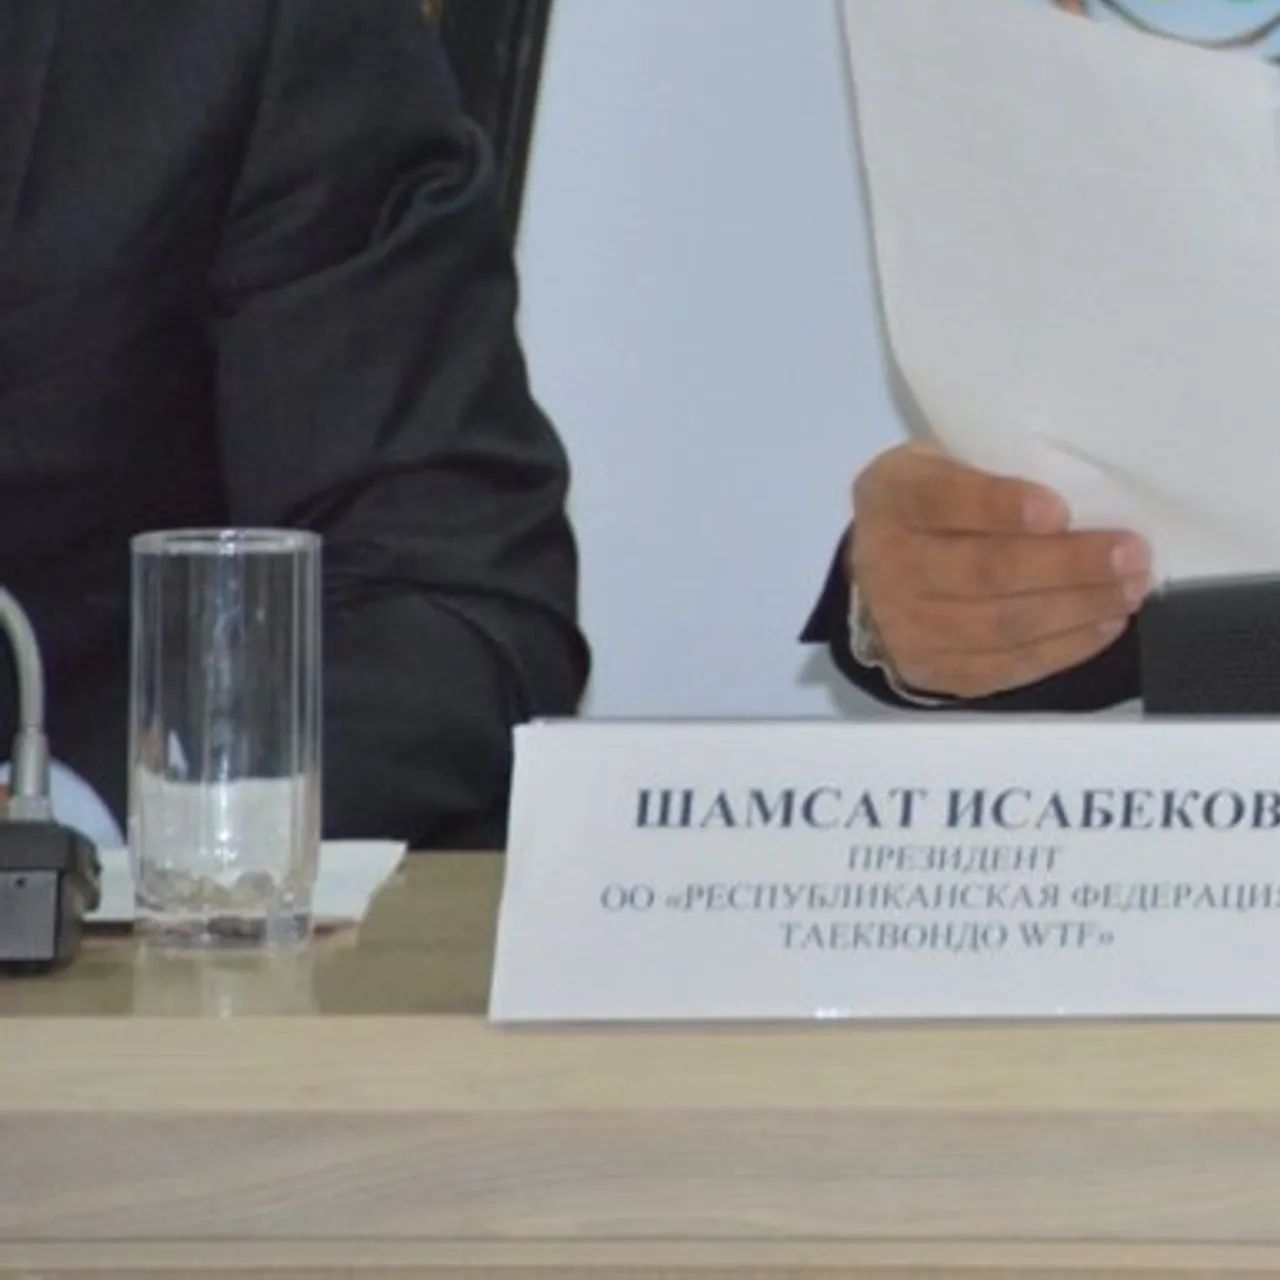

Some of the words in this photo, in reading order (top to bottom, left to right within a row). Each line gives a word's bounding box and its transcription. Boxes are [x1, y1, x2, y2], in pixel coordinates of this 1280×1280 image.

[635, 787, 928, 830] ШАМСАТ
[847, 844, 1063, 873] ПРЕЗИДЕНТ
[599, 884, 655, 911] ОО
[665, 882, 1060, 911] «РЕСПУБЛИКАНСКАЯ
[781, 920, 1007, 953] ТАЕКВОНДО
[1018, 920, 1115, 949] WTF»
